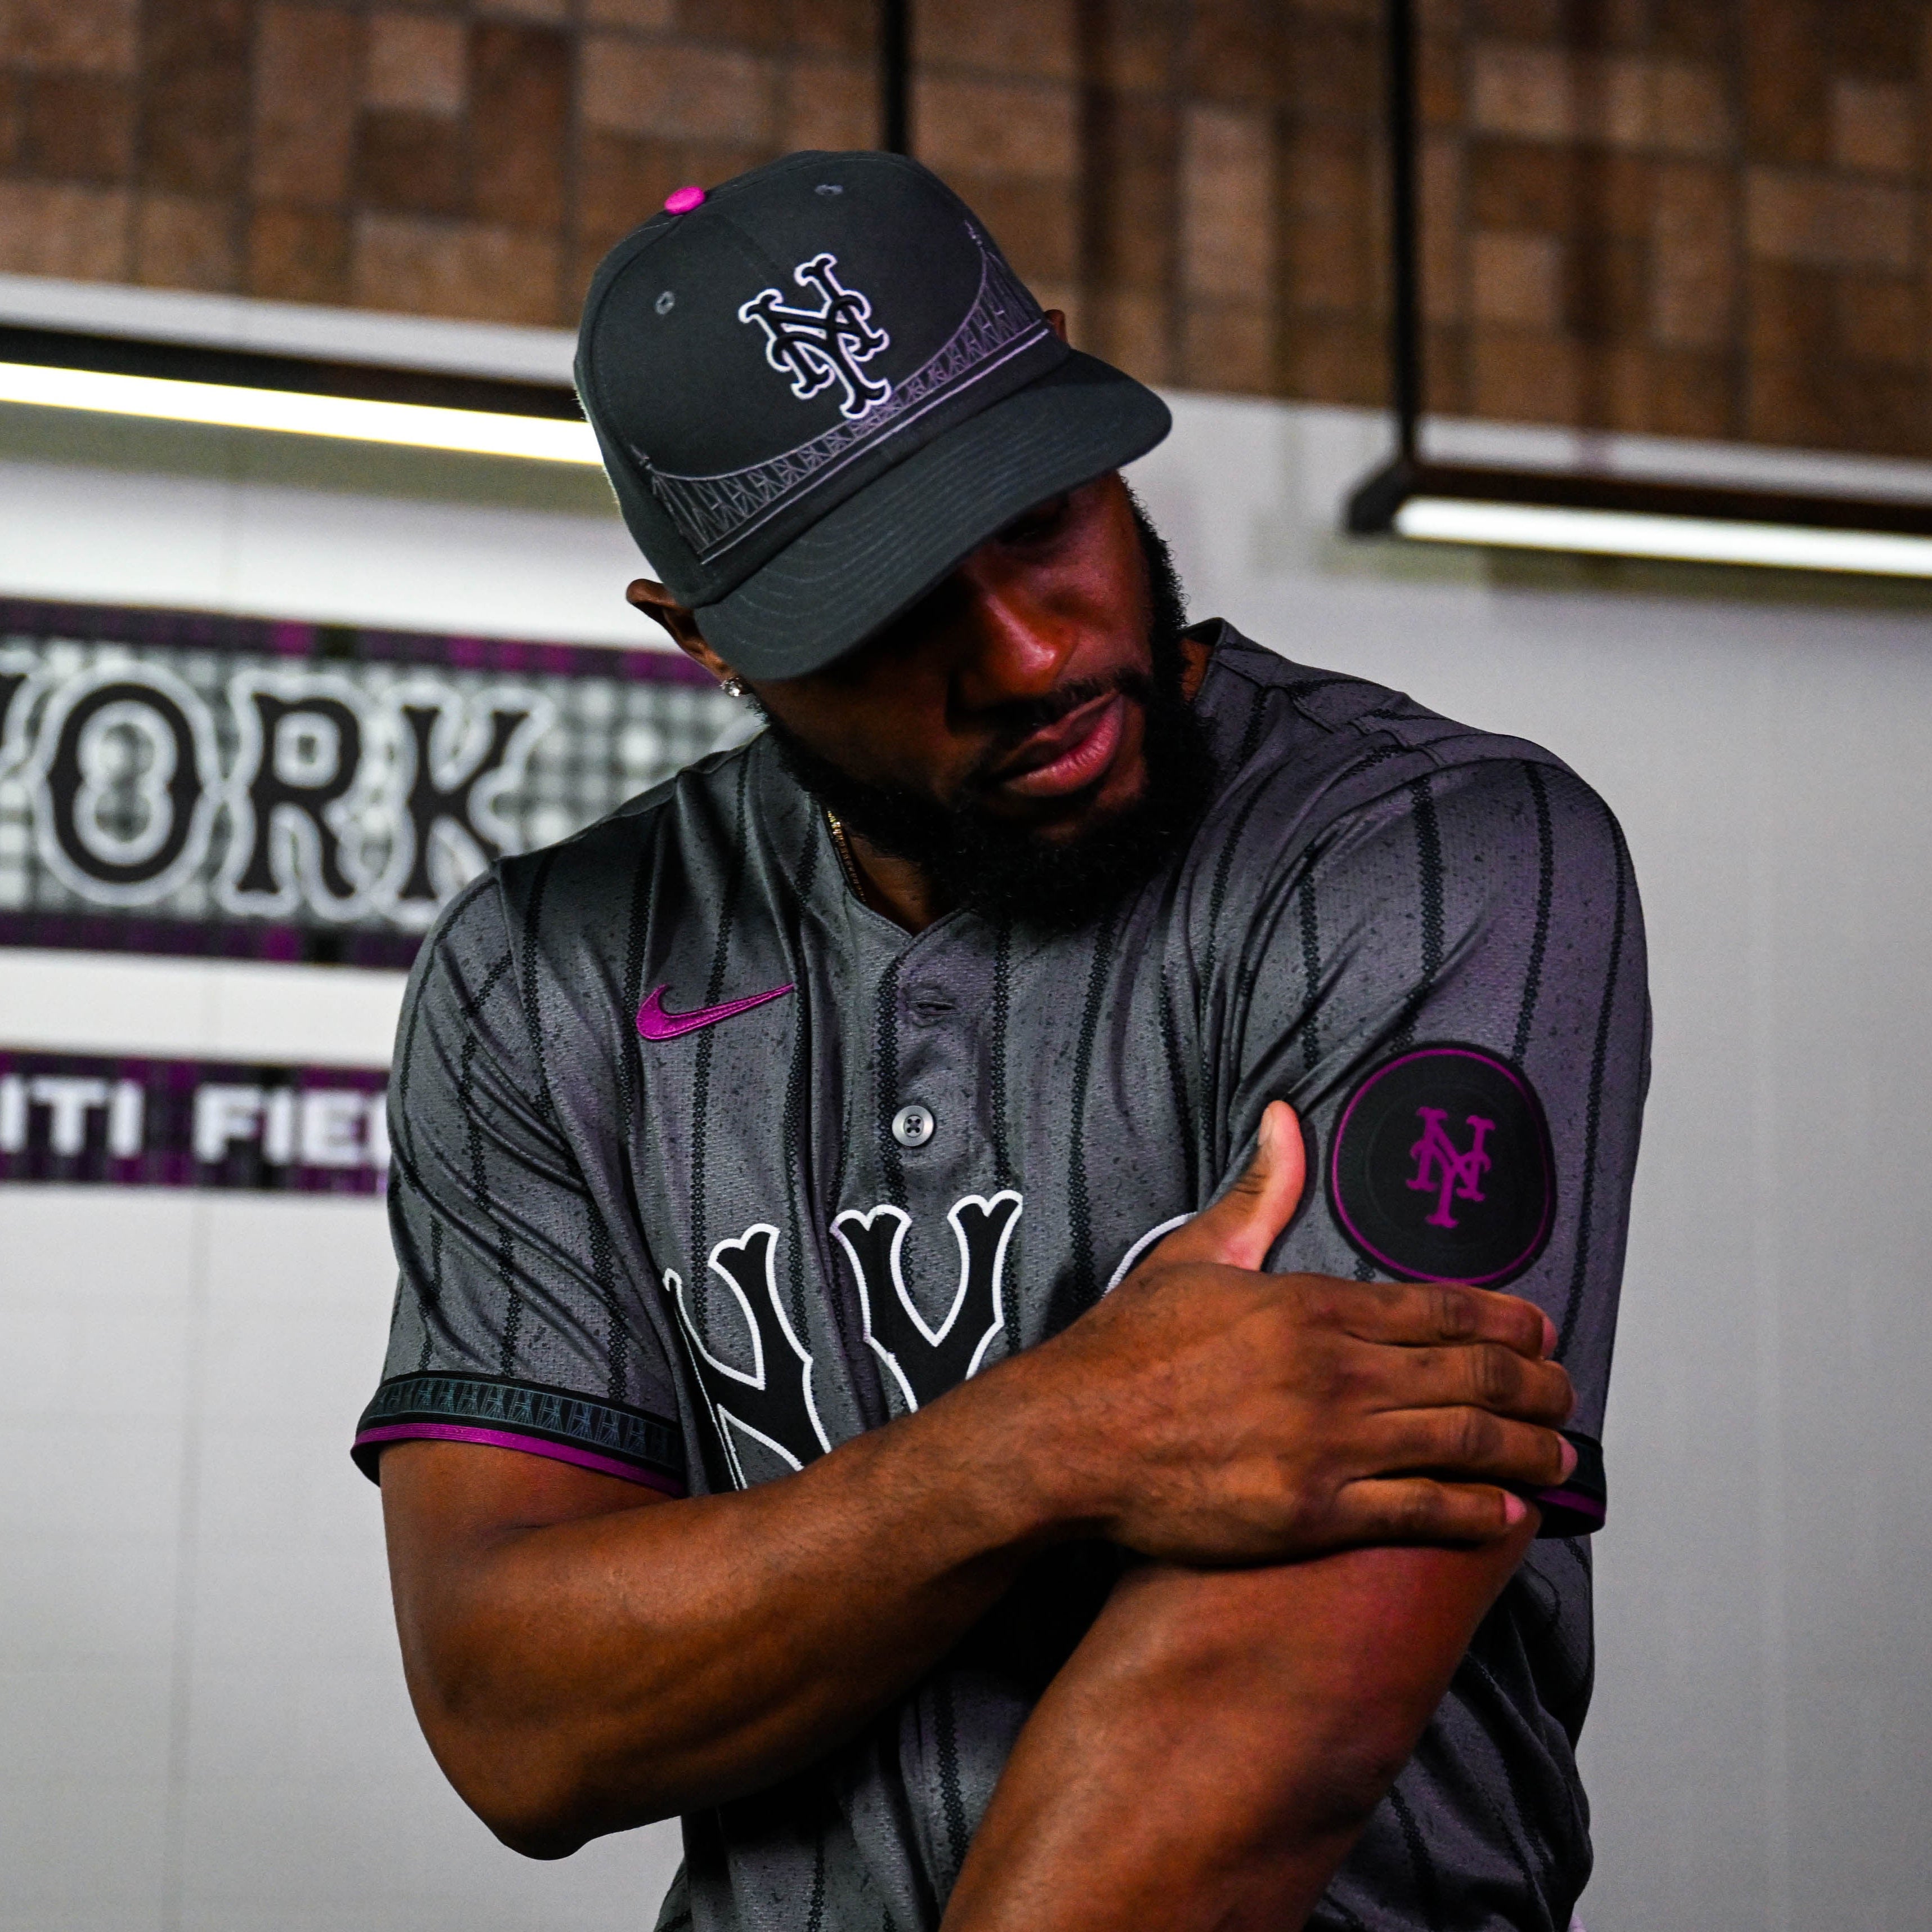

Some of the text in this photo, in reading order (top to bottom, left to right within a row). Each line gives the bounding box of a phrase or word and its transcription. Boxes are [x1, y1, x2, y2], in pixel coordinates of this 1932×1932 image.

[738, 253, 892, 420] NY
[0, 664, 551, 919] ORK
[663, 1189, 1197, 1491] NY
